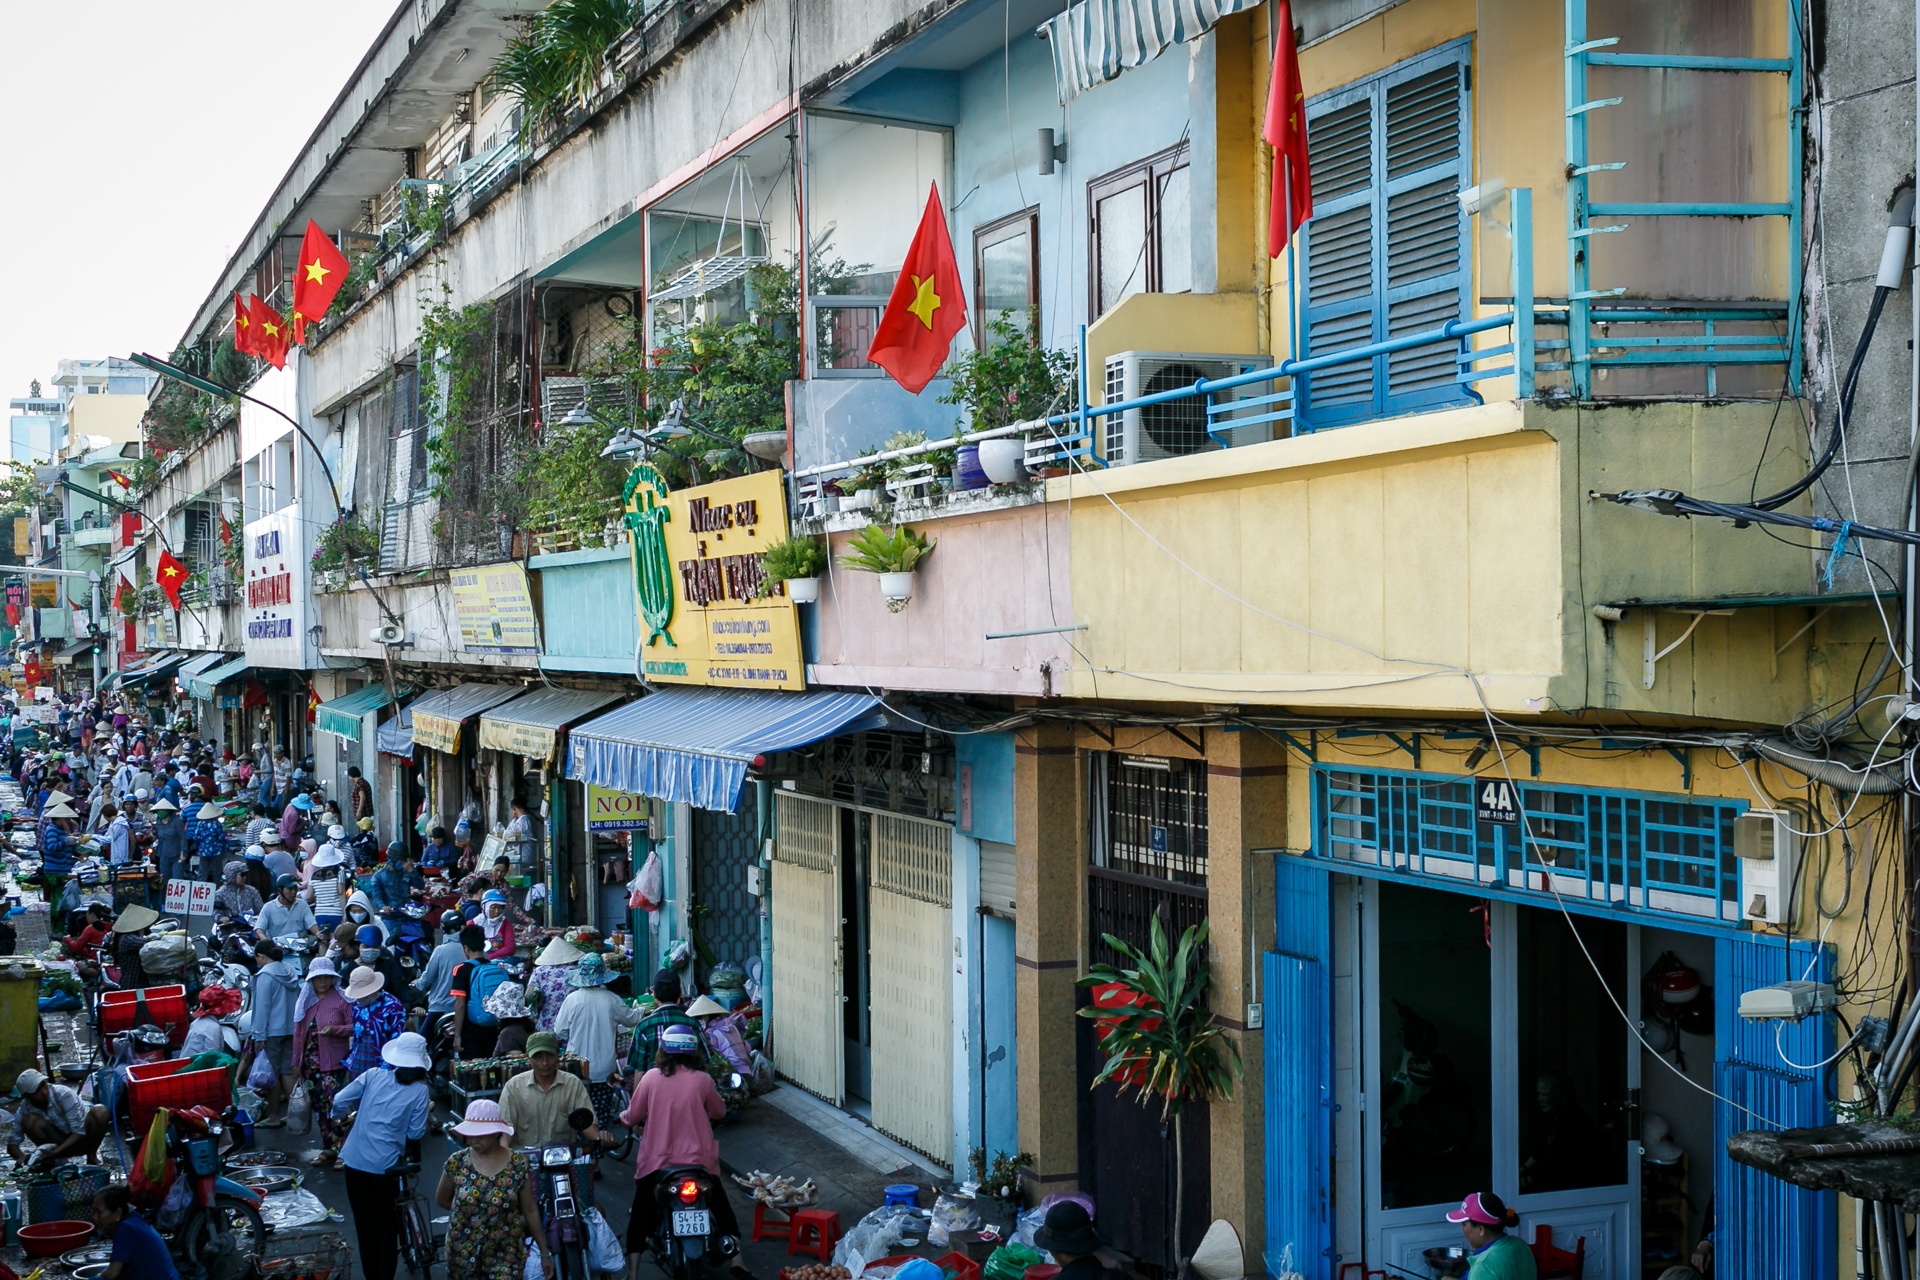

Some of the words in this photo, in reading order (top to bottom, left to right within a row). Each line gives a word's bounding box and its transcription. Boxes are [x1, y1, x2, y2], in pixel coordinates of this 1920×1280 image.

[688, 496, 733, 541] Nhạc
[735, 499, 759, 537] cụ
[1482, 782, 1512, 811] 4A
[590, 821, 603, 829] LH:
[604, 820, 648, 828] 0919.382.545
[167, 901, 185, 910] 10.000
[678, 1211, 704, 1223] 54-F5
[679, 1222, 705, 1234] 2260
